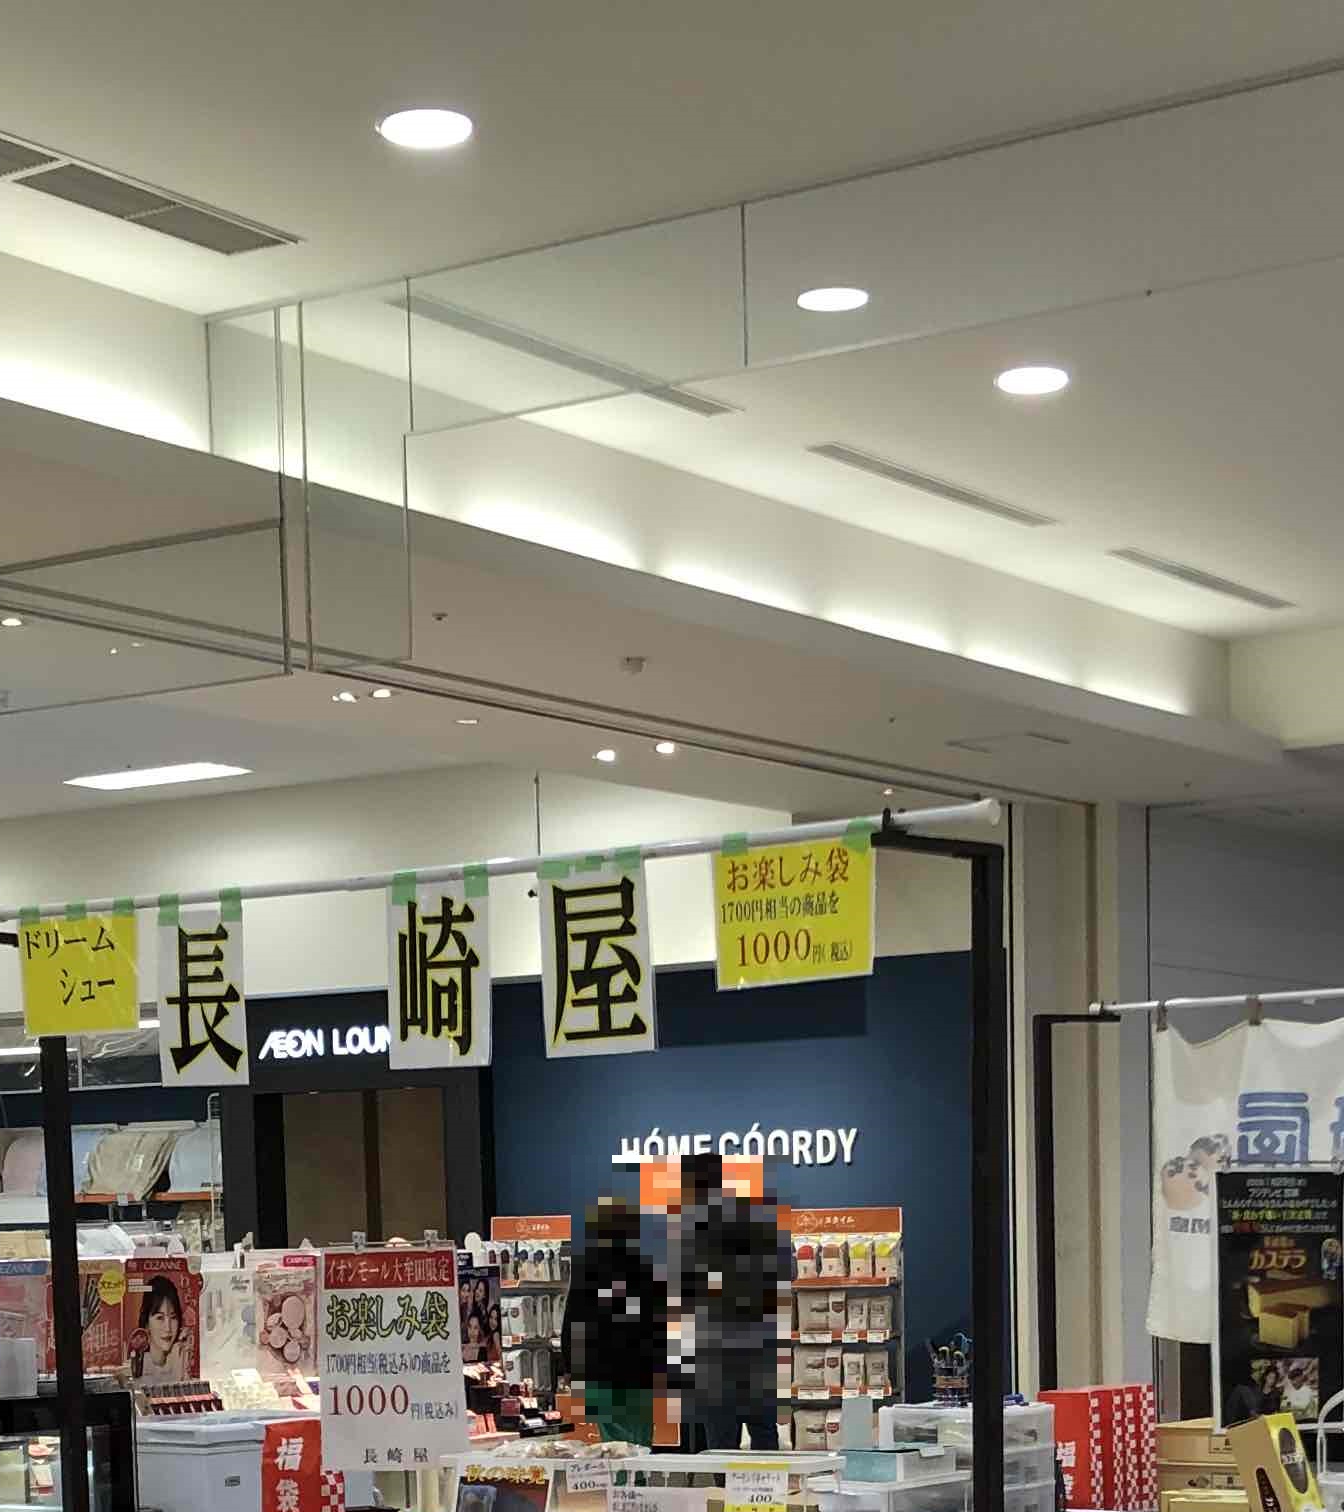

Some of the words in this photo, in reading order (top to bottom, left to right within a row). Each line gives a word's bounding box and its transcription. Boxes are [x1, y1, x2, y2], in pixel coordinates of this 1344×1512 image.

[726, 847, 849, 892] お楽しみ袋
[22, 926, 116, 959] ドリーム
[59, 968, 116, 1006] シュー
[1248, 1248, 1307, 1270] カステラ
[326, 1290, 450, 1341] お楽しみ袋
